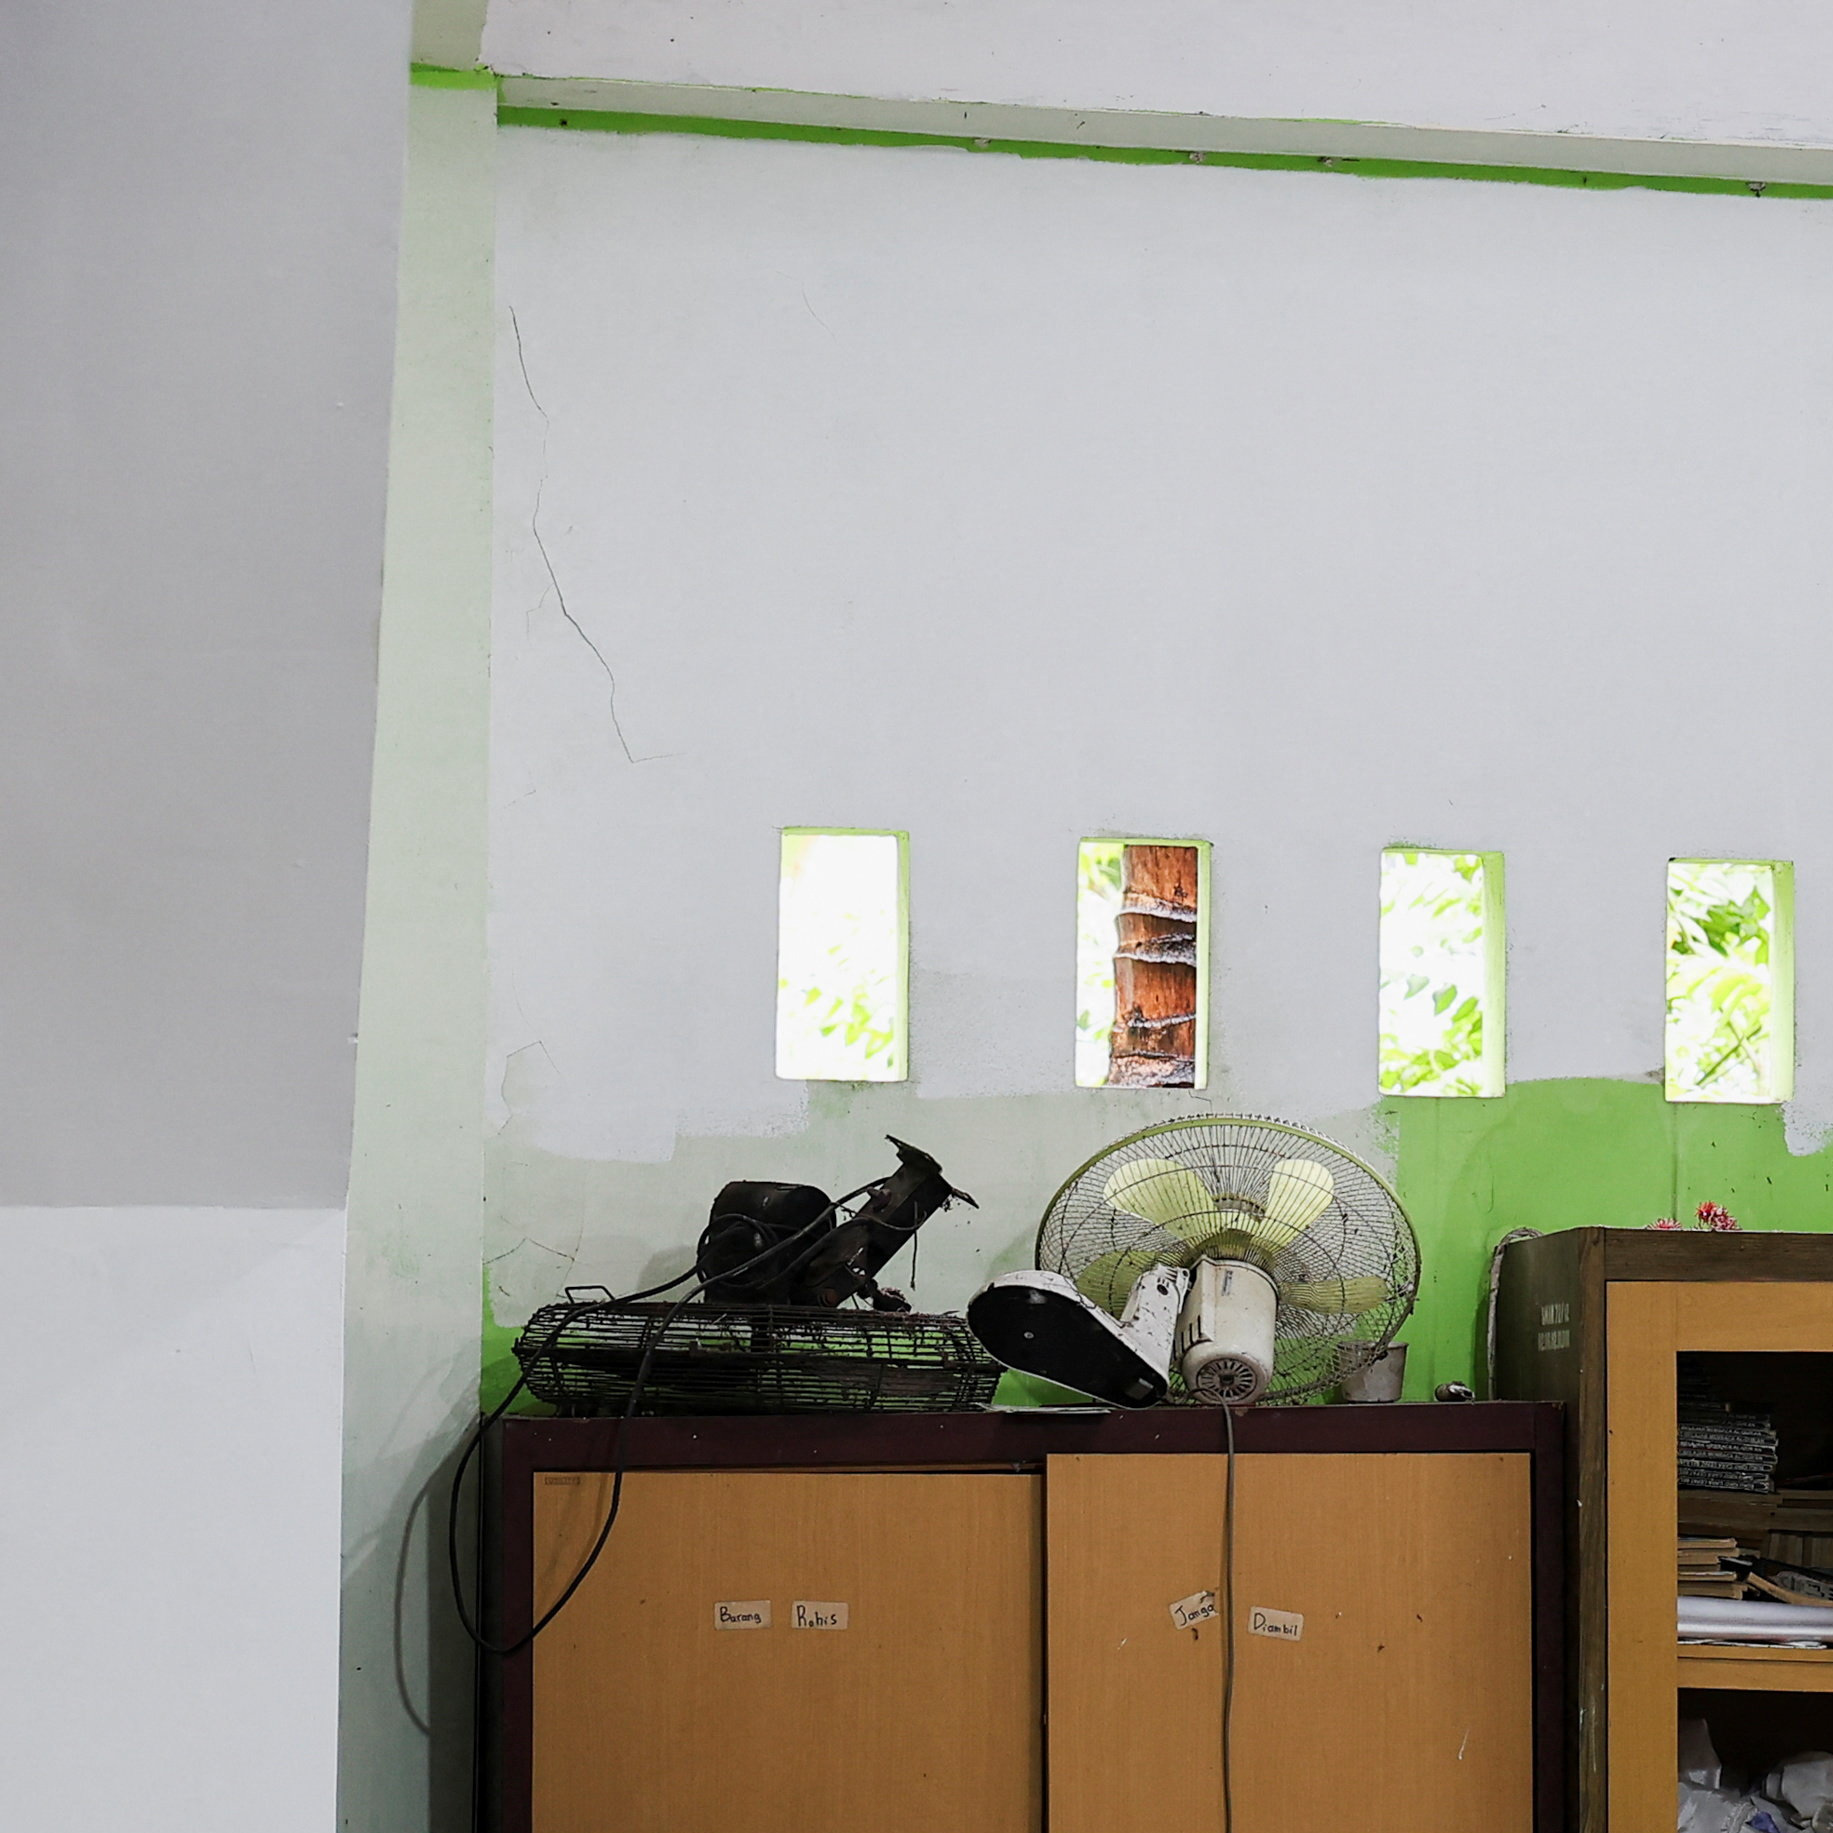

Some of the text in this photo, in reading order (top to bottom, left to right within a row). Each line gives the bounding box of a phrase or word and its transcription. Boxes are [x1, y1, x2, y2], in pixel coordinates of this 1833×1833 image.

[720, 1606, 762, 1623] Barang
[796, 1604, 838, 1627] Rohis
[1175, 1605, 1217, 1627] Janga
[1254, 1613, 1298, 1636] Diambil
